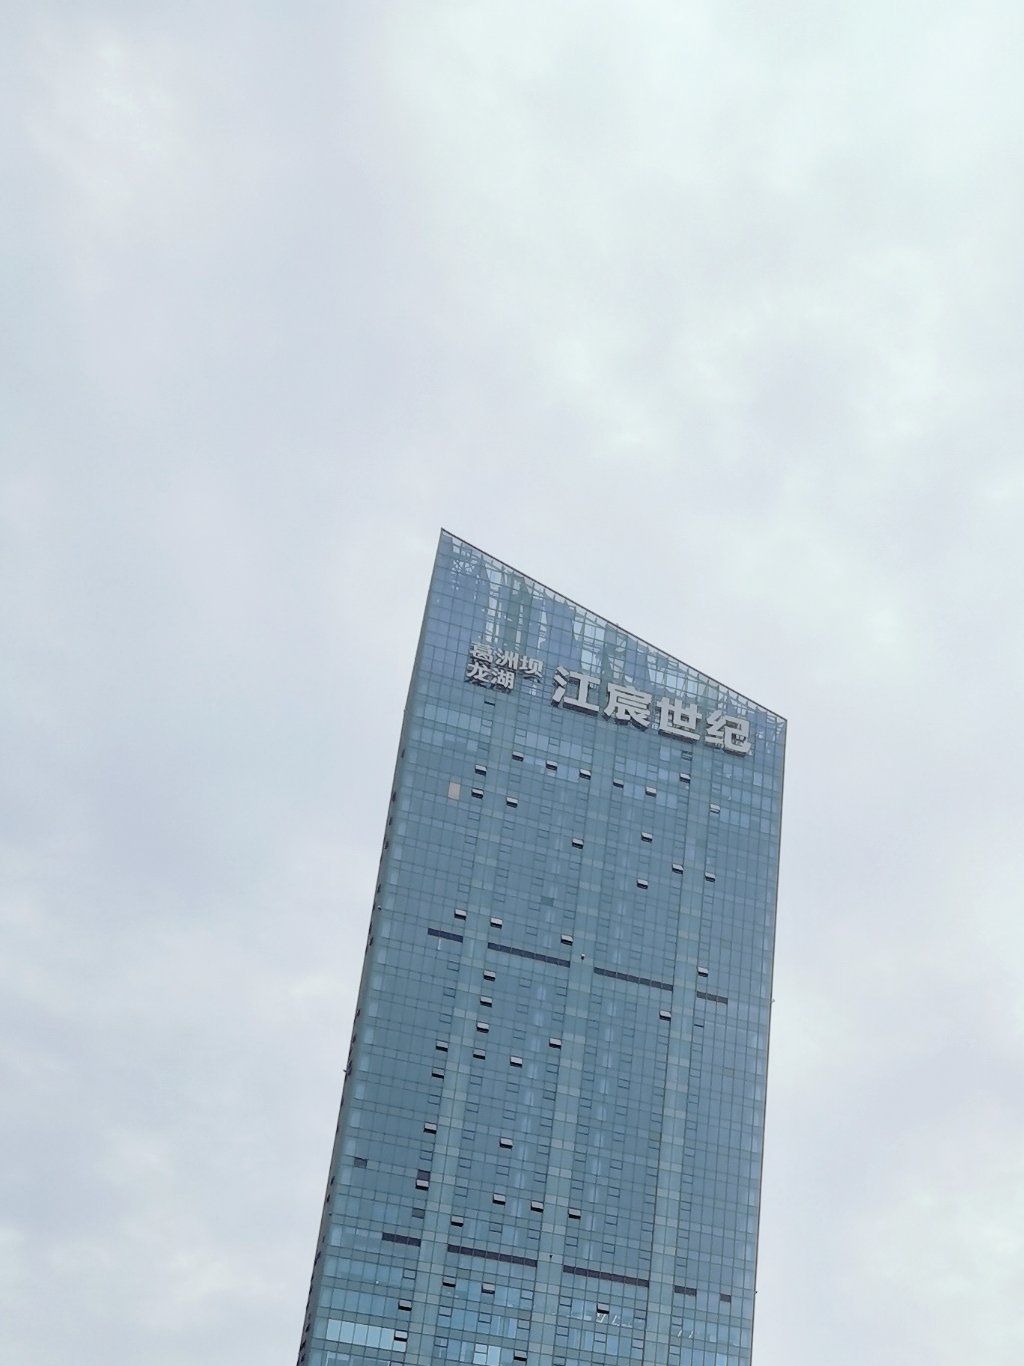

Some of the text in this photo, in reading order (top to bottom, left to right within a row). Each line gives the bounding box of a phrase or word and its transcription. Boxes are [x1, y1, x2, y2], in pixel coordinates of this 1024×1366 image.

[466, 661, 515, 690] 龙湖
[551, 665, 752, 756] 江宸世纪
